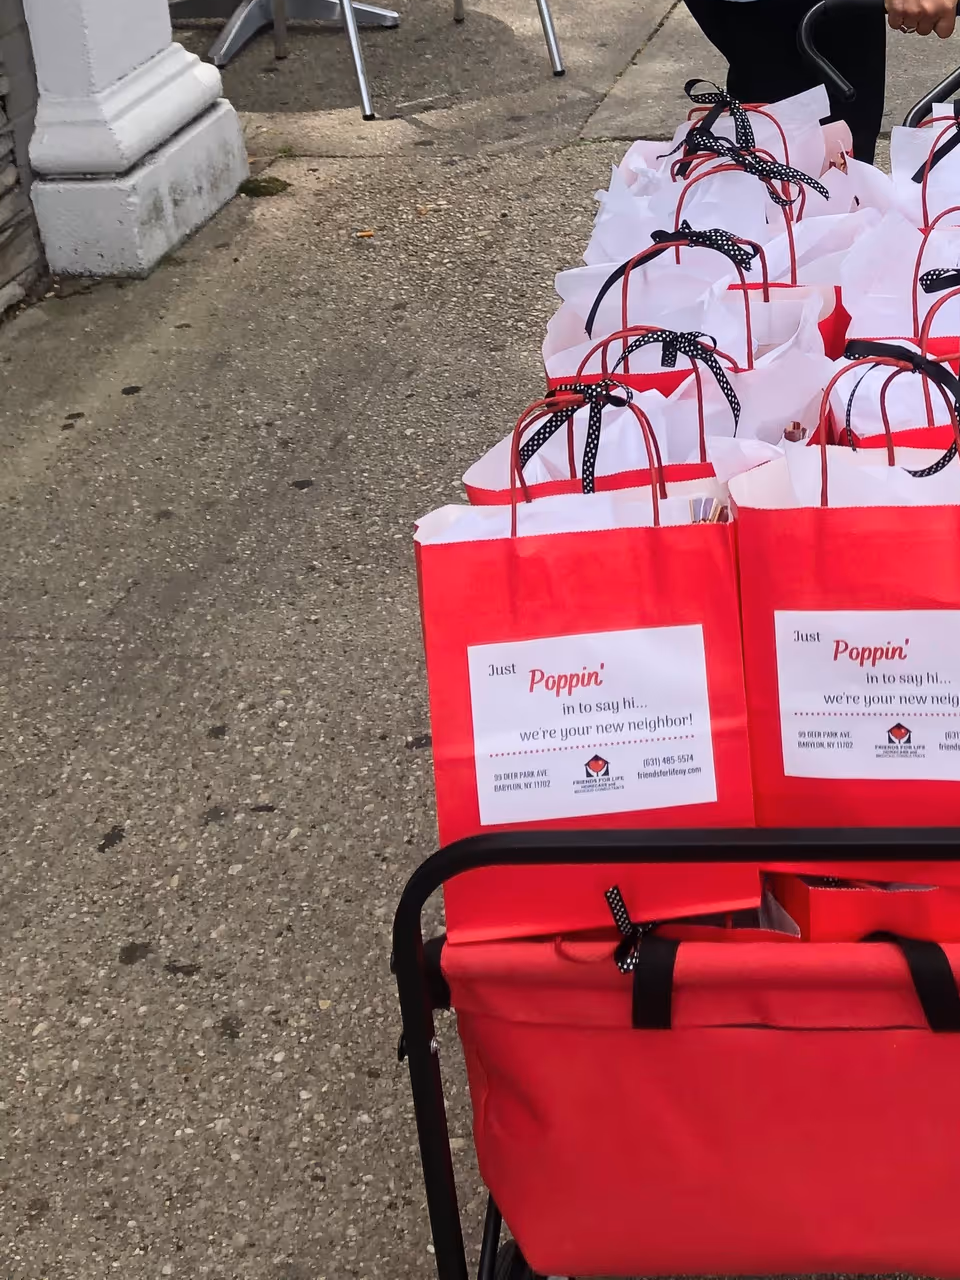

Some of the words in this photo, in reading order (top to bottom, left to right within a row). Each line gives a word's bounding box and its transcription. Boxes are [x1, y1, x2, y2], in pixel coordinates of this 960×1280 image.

[794, 630, 820, 642] Just
[833, 638, 909, 667] Poppin'
[488, 663, 516, 676] Just
[529, 662, 604, 697] Poppin'
[866, 672, 878, 684] in
[882, 673, 895, 684] to
[899, 674, 923, 687] say
[926, 672, 951, 684] hi...
[562, 703, 575, 715] in
[579, 702, 592, 714] to
[595, 700, 619, 714] say
[622, 697, 648, 709] hi...
[824, 692, 860, 705] we're
[863, 695, 896, 708] your
[899, 695, 927, 705] new
[520, 727, 556, 741] we're
[560, 725, 592, 741] your
[596, 722, 624, 734] new
[628, 713, 693, 732] neighbor!
[823, 731, 838, 739] PARK
[827, 741, 835, 749] NY
[643, 757, 661, 768] (631)
[662, 754, 694, 765] 485-5574
[503, 771, 518, 780] DEER
[519, 770, 535, 779] PARK
[637, 766, 702, 780] friendsforlifeny.com
[524, 781, 533, 790] NY
[534, 780, 551, 789] 11702
[572, 778, 597, 786] FRIENDS
